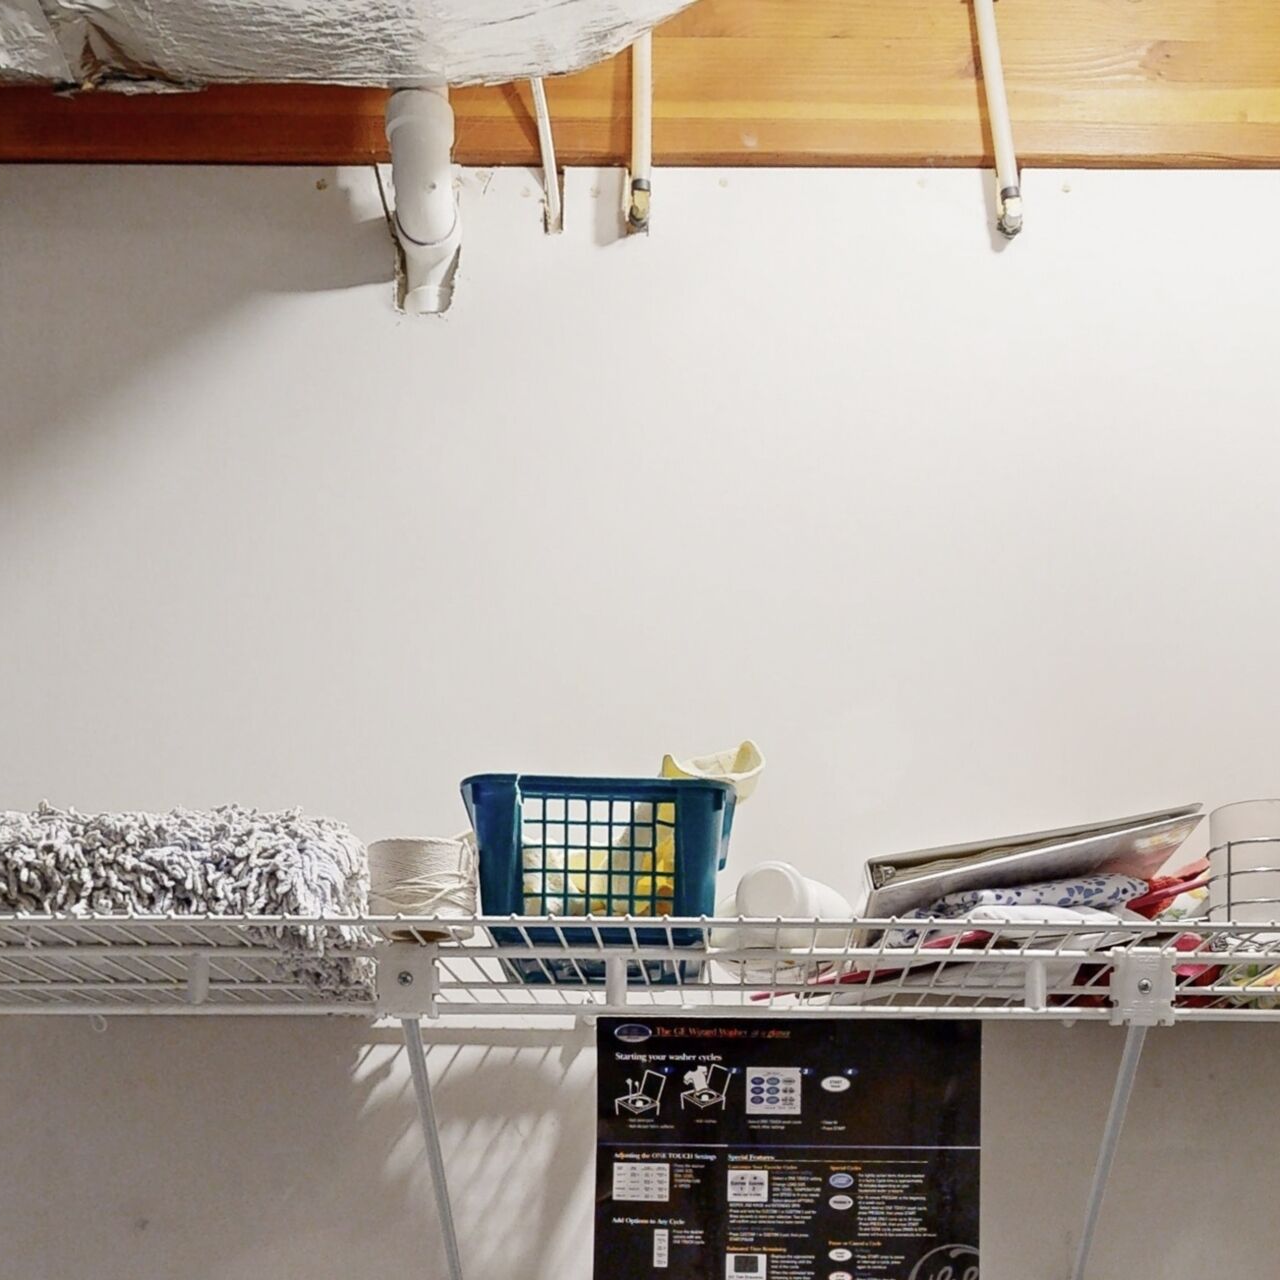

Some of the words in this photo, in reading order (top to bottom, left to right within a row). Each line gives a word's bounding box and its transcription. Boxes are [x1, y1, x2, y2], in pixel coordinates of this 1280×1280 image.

[655, 1027, 671, 1037] The
[615, 1052, 647, 1063] Starting
[648, 1054, 667, 1062] your
[669, 1052, 697, 1061] washer
[698, 1052, 723, 1062] cycles
[625, 1217, 649, 1225] Options
